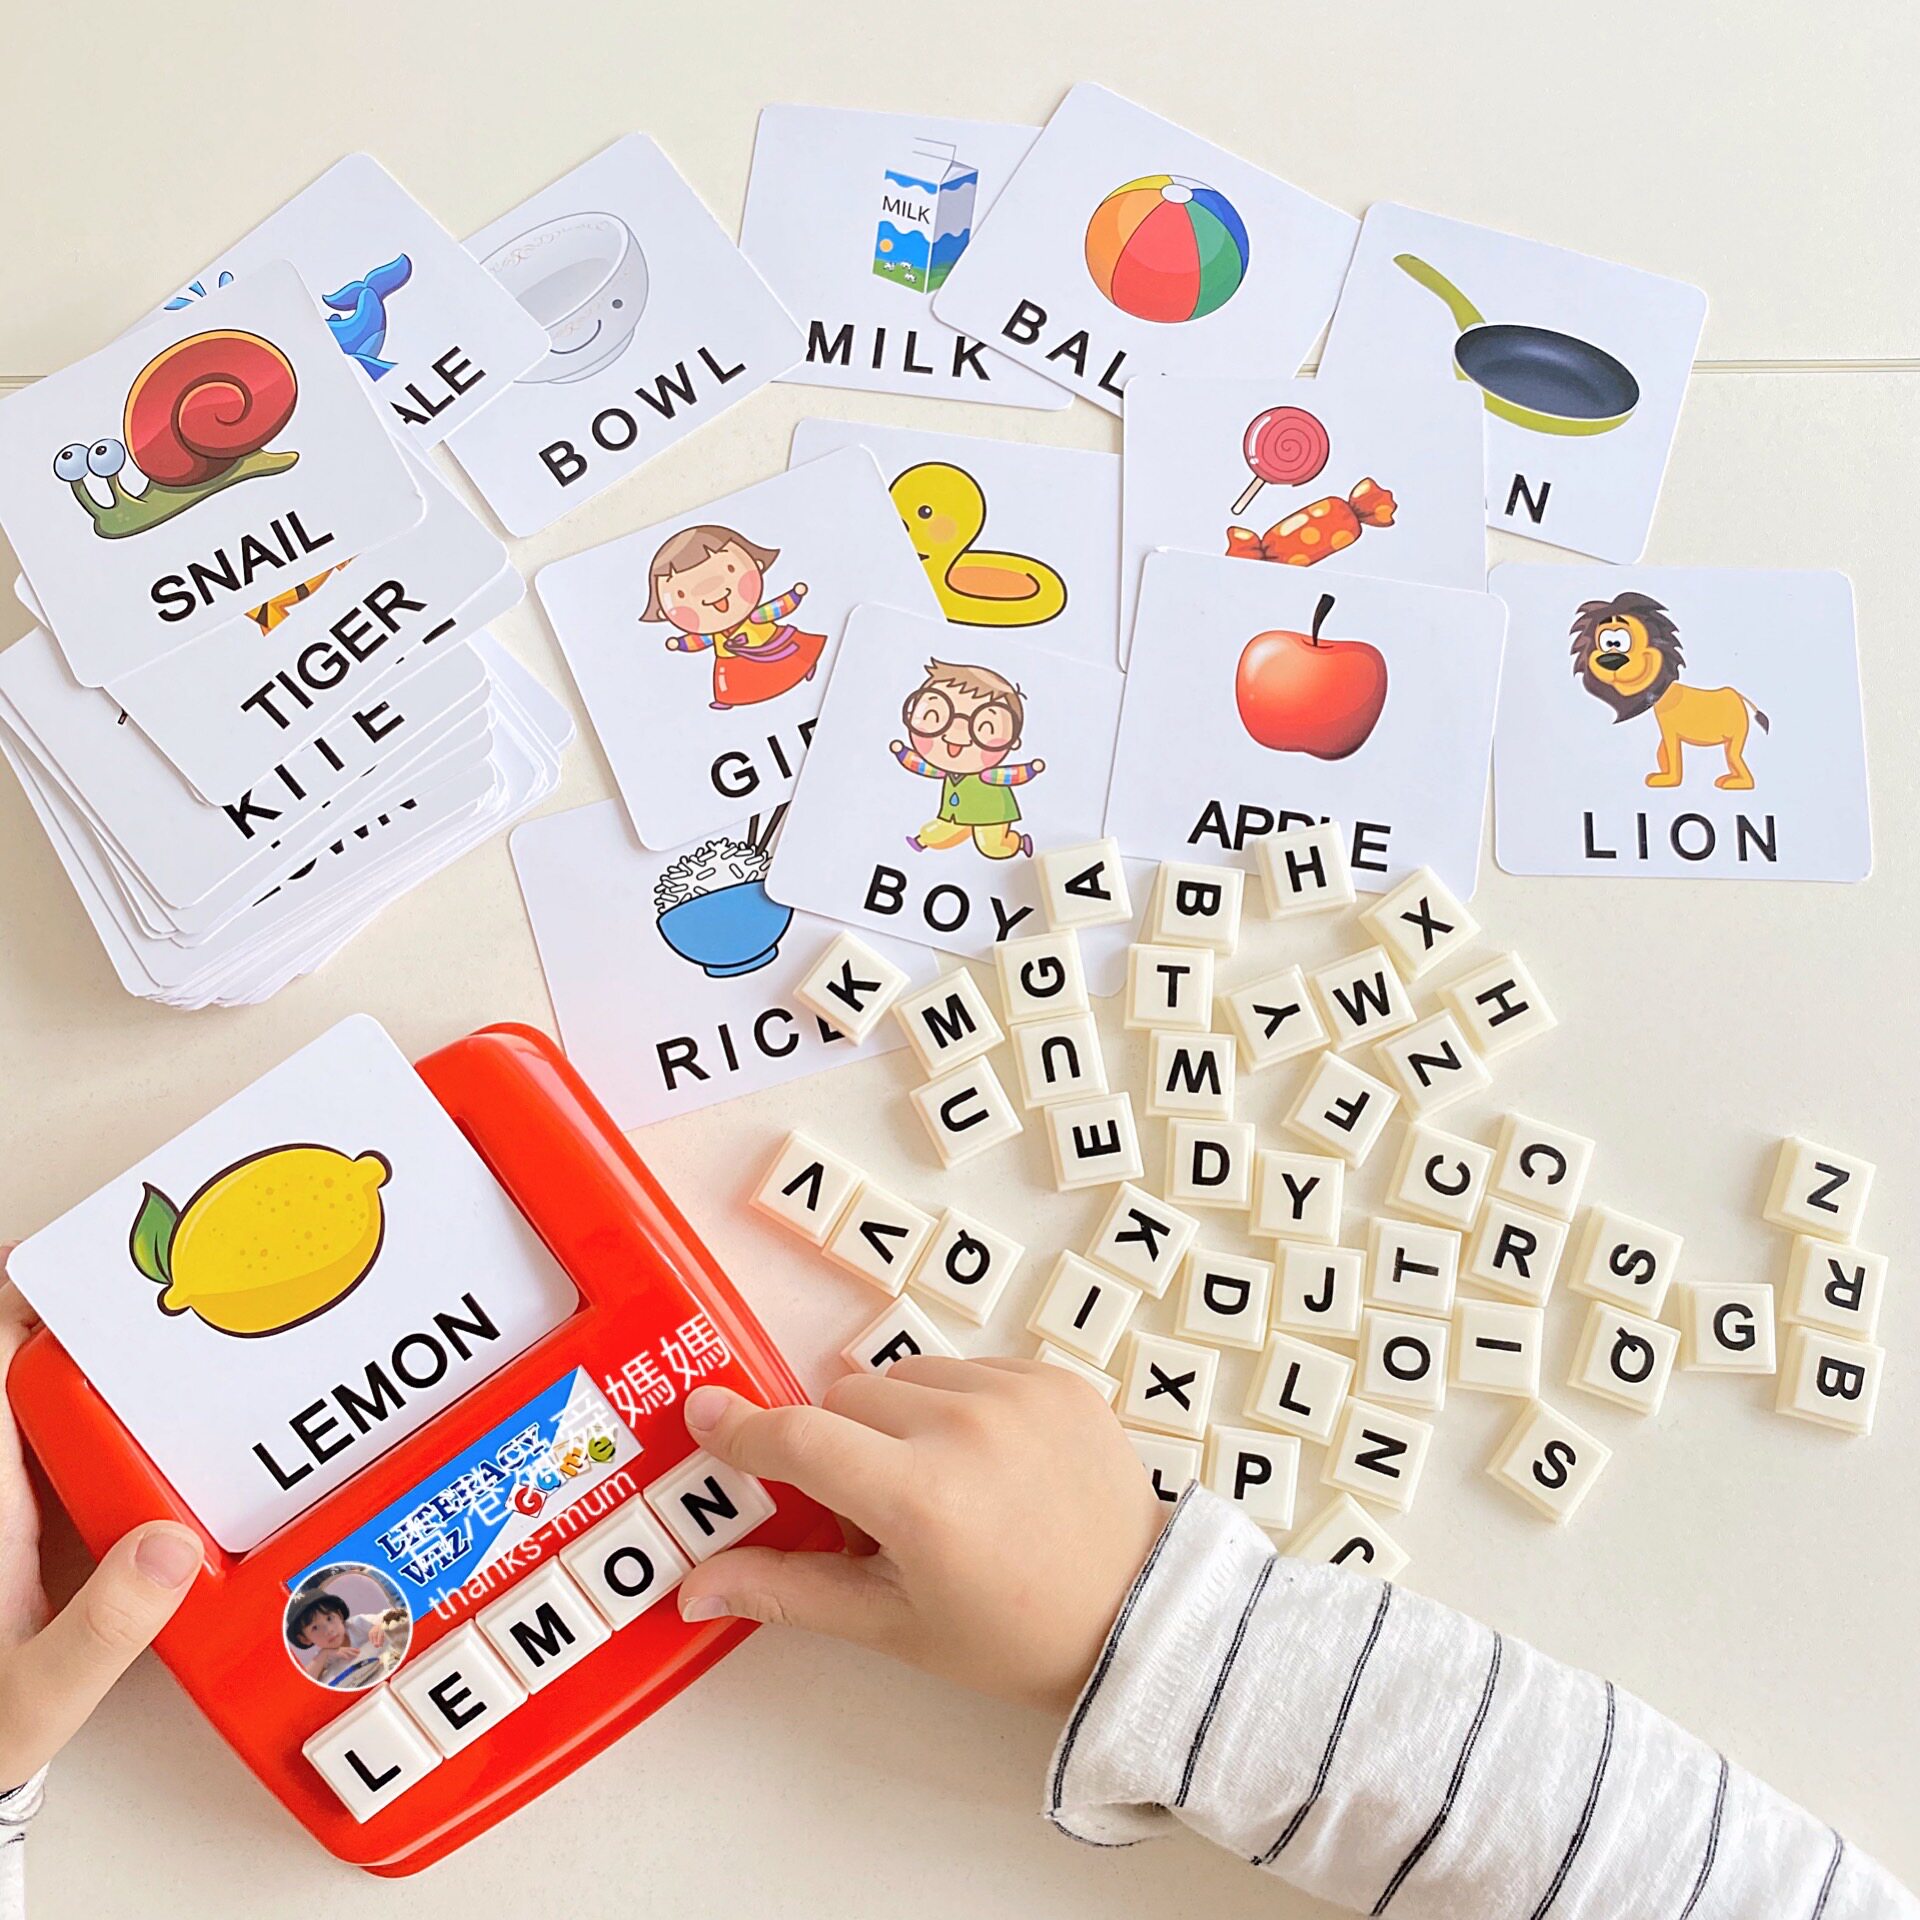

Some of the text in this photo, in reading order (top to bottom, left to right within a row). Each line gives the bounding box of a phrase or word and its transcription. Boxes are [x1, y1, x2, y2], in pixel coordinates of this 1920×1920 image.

[882, 195, 930, 225] MILK
[805, 320, 990, 381] MILK
[1001, 299, 1124, 400] BAL
[538, 346, 746, 487] BOWL
[149, 510, 335, 624] SNAIL
[240, 579, 428, 731] TIGER
[710, 717, 819, 798] GI
[1187, 799, 1392, 873] APE
[1584, 811, 1777, 862] LION
[1064, 861, 1112, 901] A
[1284, 845, 1327, 893] H
[863, 864, 1035, 942] BOY
[1176, 880, 1222, 917] B
[1400, 897, 1454, 951] X
[826, 959, 882, 1013] K
[1020, 956, 1066, 998] G
[1156, 964, 1191, 1008] T
[1332, 971, 1391, 1026] W
[921, 993, 977, 1049] M
[1252, 1003, 1301, 1040] Y
[1475, 979, 1530, 1027] H
[940, 1086, 990, 1133] U
[1324, 1091, 1370, 1132] F
[1072, 1119, 1121, 1159] E
[1192, 1140, 1230, 1186] D
[1425, 1154, 1471, 1196] C
[1519, 1143, 1567, 1185] C
[1281, 1173, 1320, 1220] Y
[945, 1229, 991, 1285] Q
[1114, 1208, 1171, 1262] K
[1492, 1223, 1537, 1279] R
[1392, 1247, 1439, 1283] T
[1609, 1243, 1656, 1285] S
[1824, 1258, 1866, 1312] R
[1203, 1273, 1251, 1315] D
[1303, 1266, 1335, 1313] J
[1713, 1303, 1756, 1352] G
[1383, 1336, 1431, 1381] O
[1610, 1327, 1655, 1384] Q
[1816, 1356, 1866, 1401] B
[252, 1292, 501, 1491] LEMON
[1144, 1362, 1196, 1412] X
[1278, 1362, 1311, 1416] L
[1233, 1451, 1272, 1500] P
[1532, 1440, 1576, 1489] S
[377, 1422, 549, 1562] LITERACY
[398, 1524, 471, 1589] WIZ
